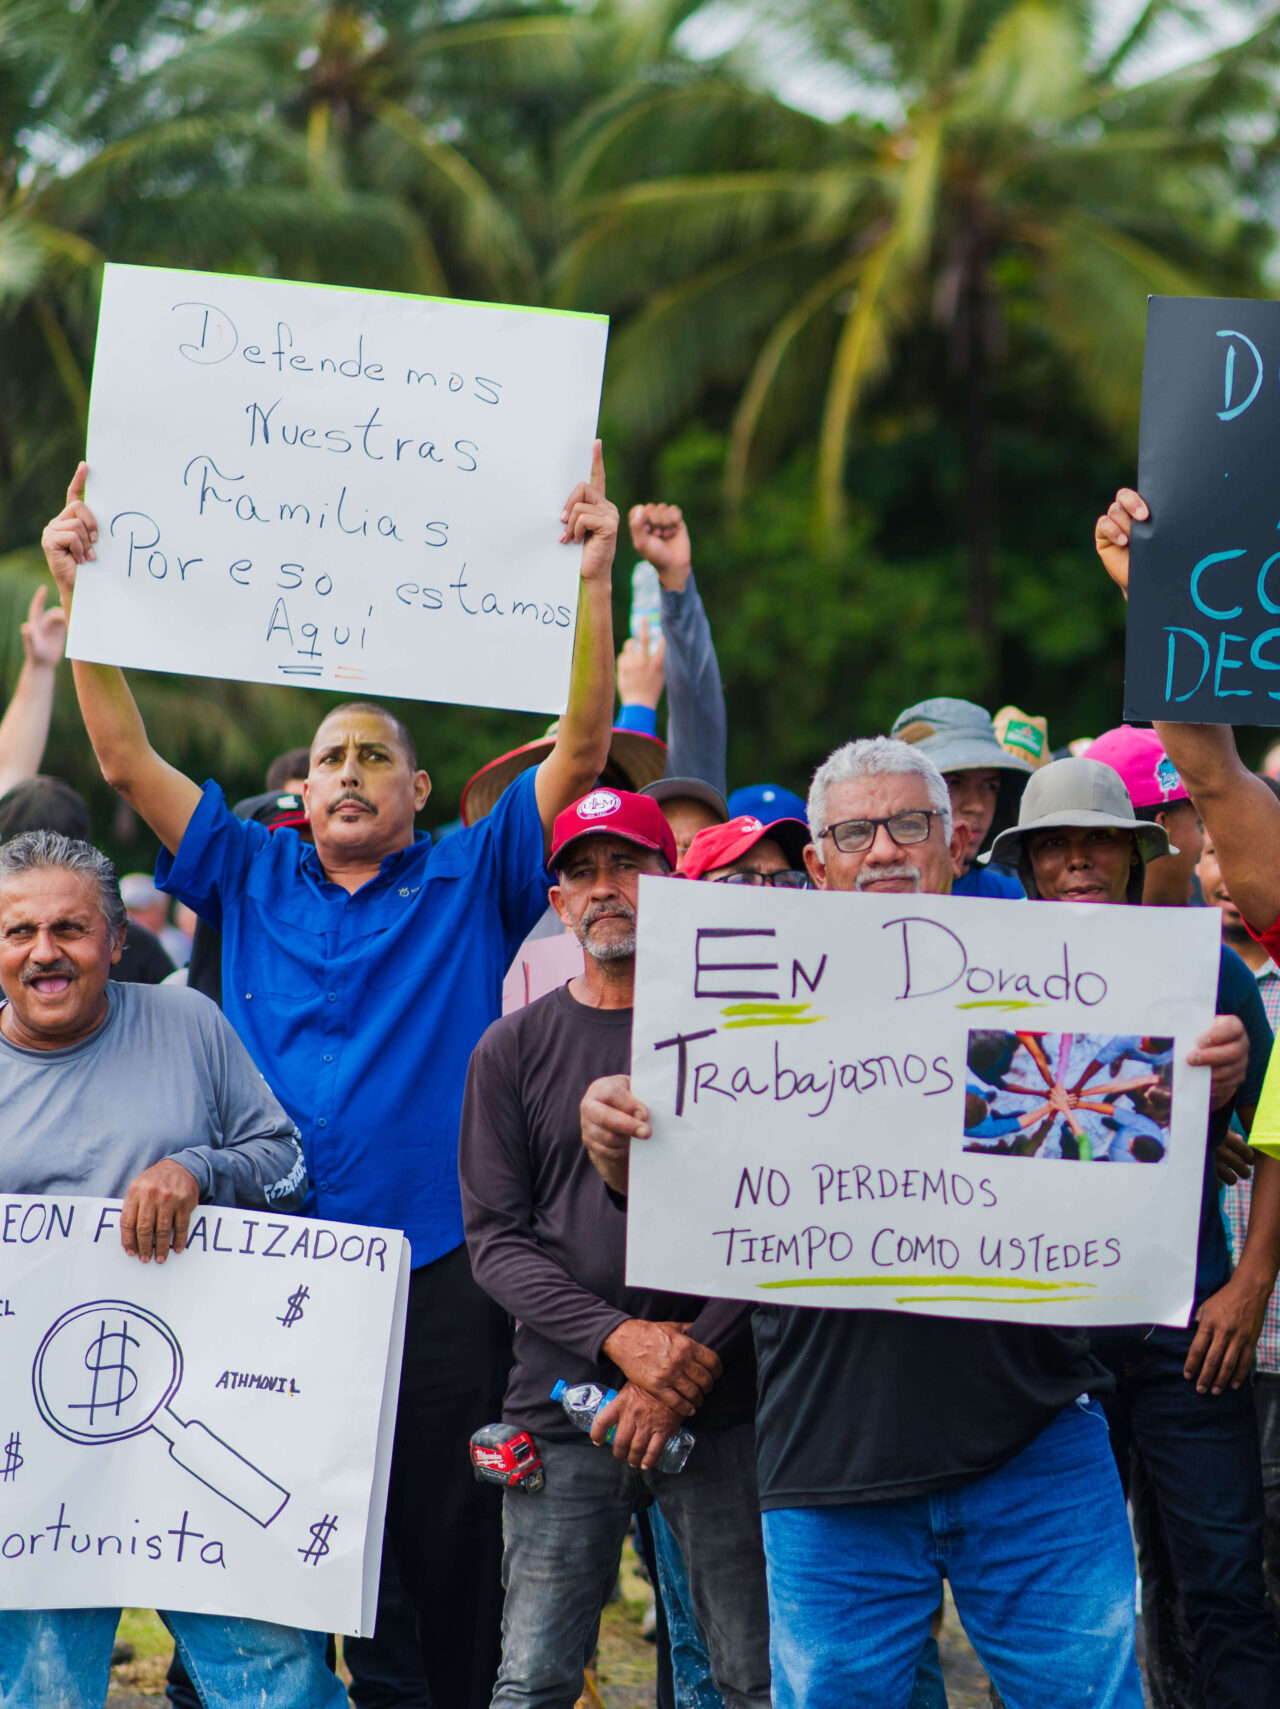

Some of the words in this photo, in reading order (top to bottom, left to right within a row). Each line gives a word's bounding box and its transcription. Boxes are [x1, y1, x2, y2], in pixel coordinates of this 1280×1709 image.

[170, 299, 505, 407] Defendemos
[244, 395, 483, 472] Nuestras
[184, 452, 450, 548] Familias
[109, 508, 204, 581] Por
[394, 561, 572, 630] estamos
[265, 593, 374, 660] Aquí
[881, 916, 1109, 1009] Dorado
[733, 1165, 792, 1210] NO
[810, 1162, 998, 1209] PERDEMOS
[711, 1224, 854, 1271] TIEMPO
[870, 1226, 961, 1272] COMO
[979, 1234, 1122, 1273] USTEDES
[214, 1369, 302, 1398] ATHMOVIL
